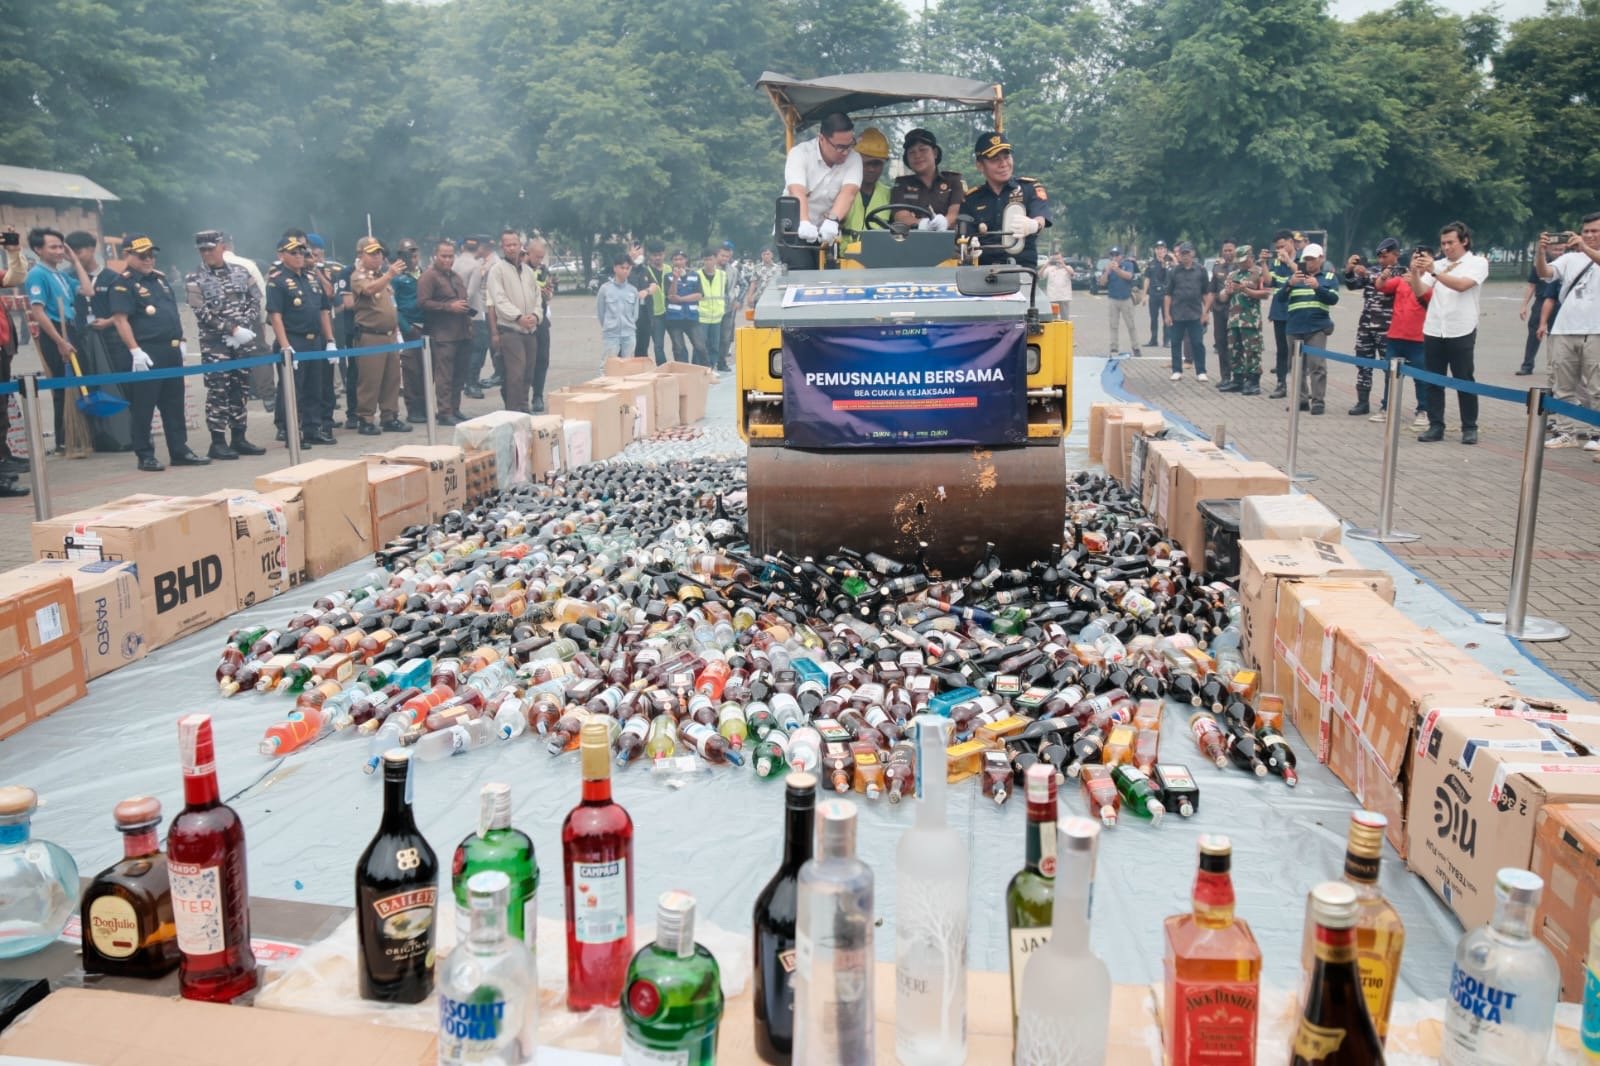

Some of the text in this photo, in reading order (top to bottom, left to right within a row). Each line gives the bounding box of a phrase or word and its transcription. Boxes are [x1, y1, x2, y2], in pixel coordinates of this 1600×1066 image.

[804, 287, 864, 295] BEA
[805, 368, 1005, 386] PEMUSNAHAN BERSAMA
[854, 389, 870, 397] BEA
[871, 389, 897, 397] CUKAI
[906, 387, 956, 396] KEJAKSAAN
[154, 553, 222, 615] BHD
[95, 597, 110, 655] PASEO
[581, 864, 618, 878] CAMPARI
